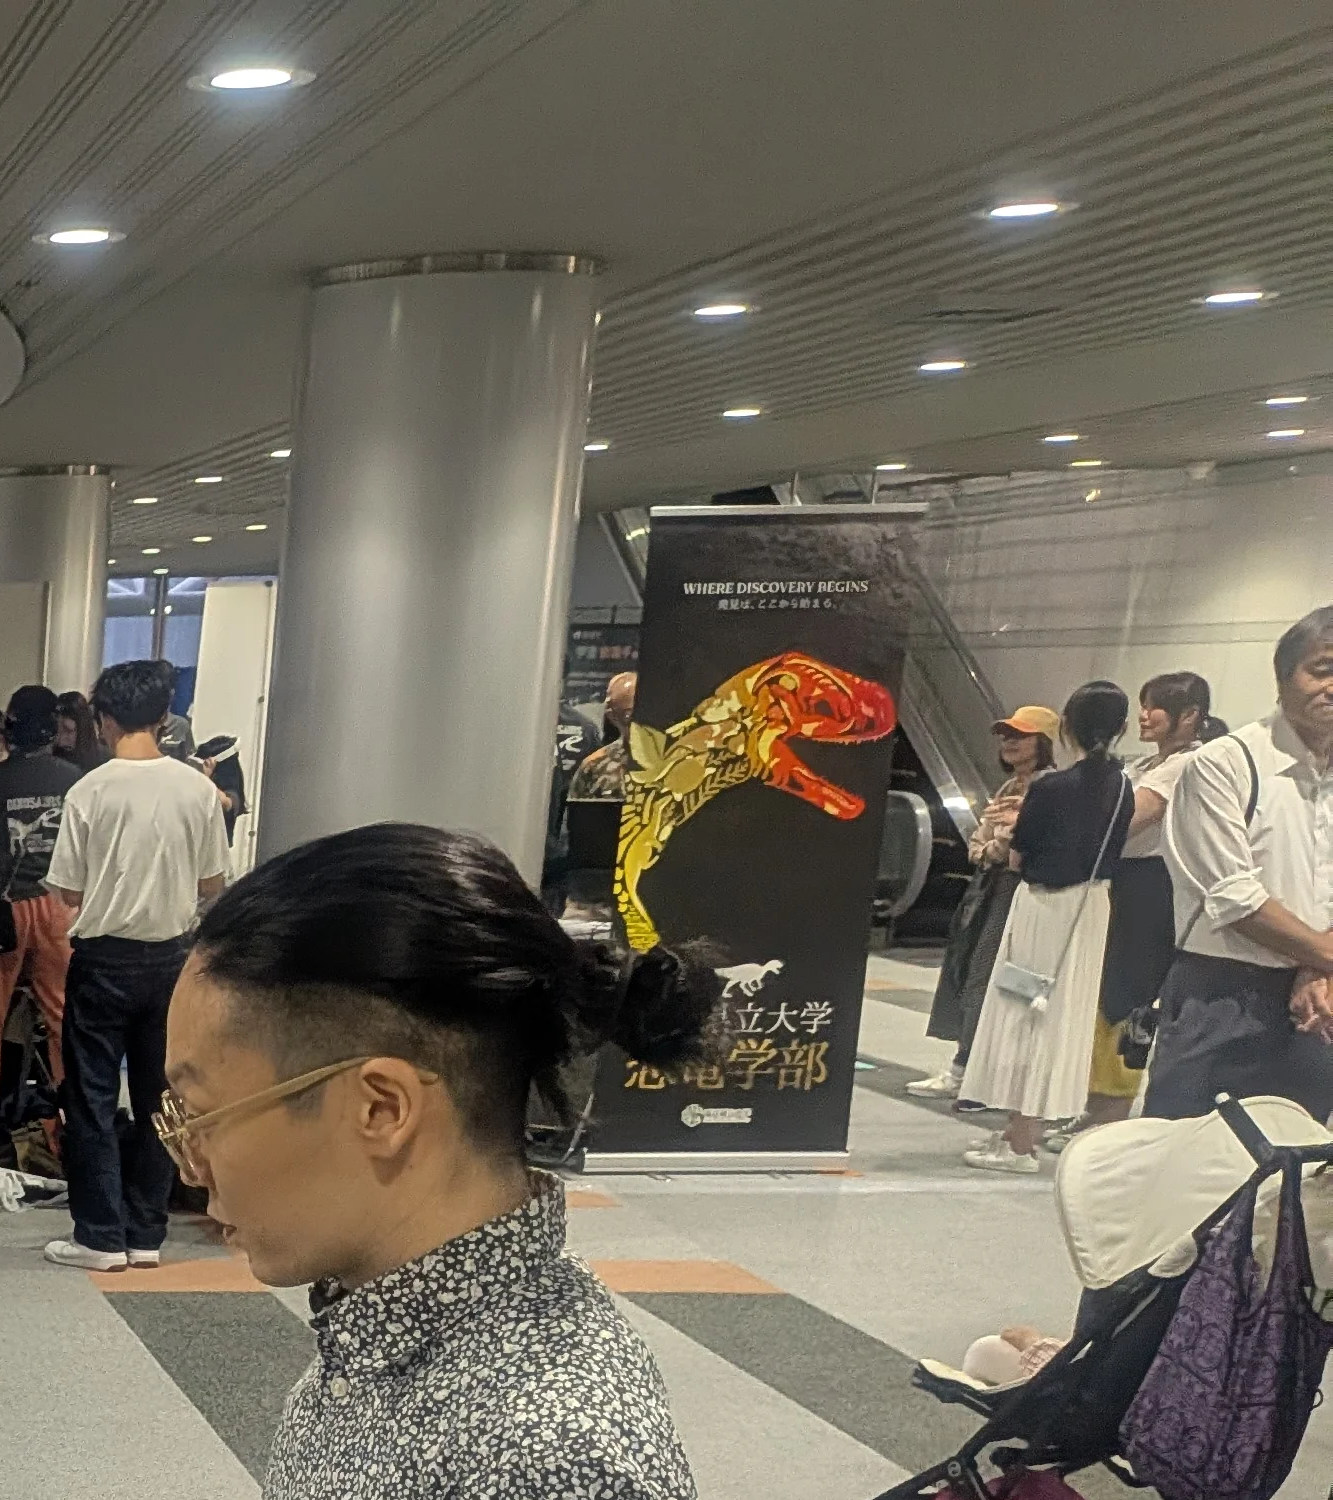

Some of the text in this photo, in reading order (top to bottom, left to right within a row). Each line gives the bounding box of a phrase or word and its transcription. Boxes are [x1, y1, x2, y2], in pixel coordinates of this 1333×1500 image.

[683, 579, 869, 595] WHERE DISCOVERY BEGINS
[719, 1001, 834, 1034] 立大学
